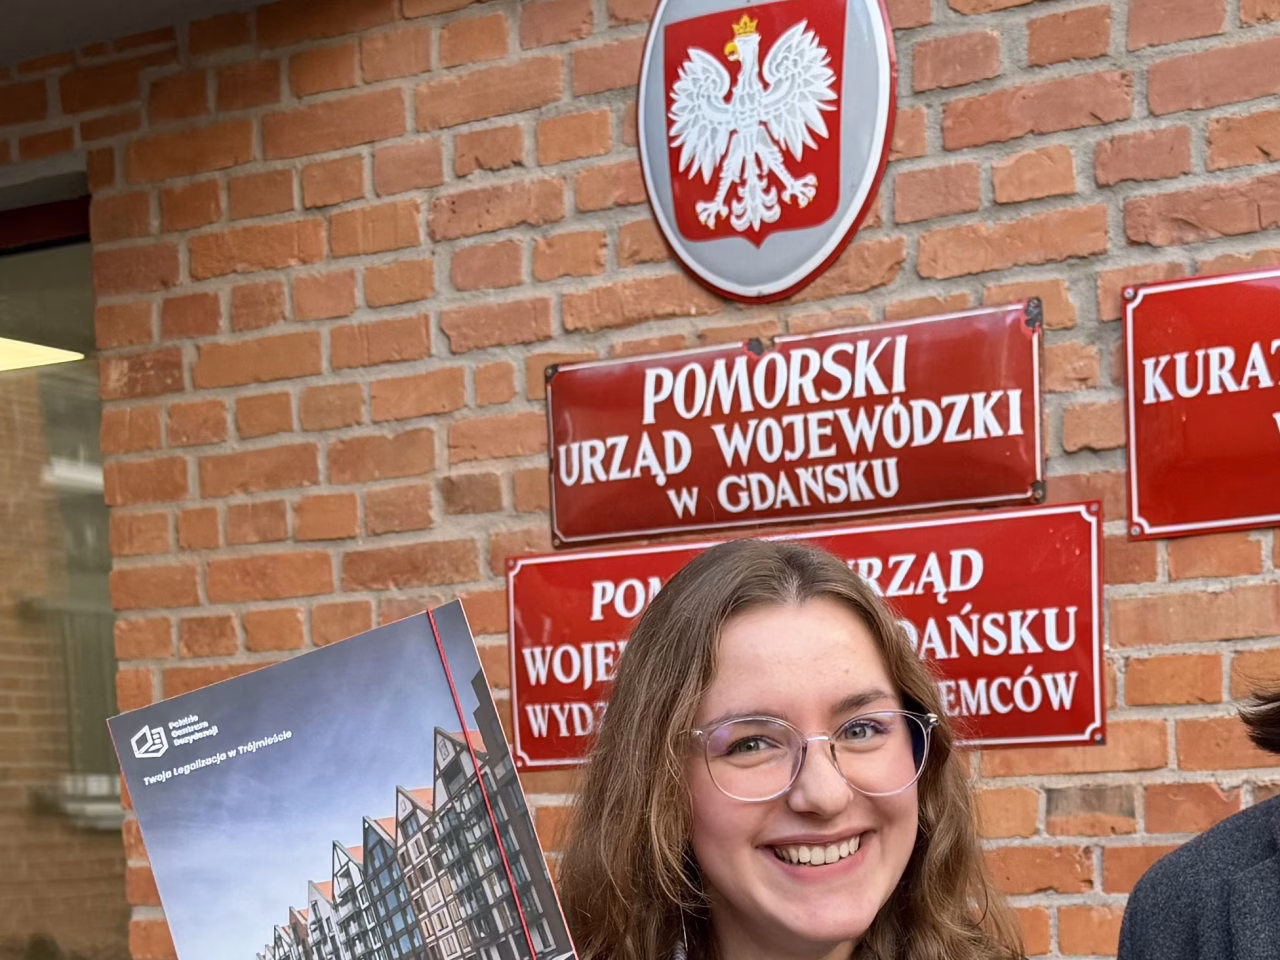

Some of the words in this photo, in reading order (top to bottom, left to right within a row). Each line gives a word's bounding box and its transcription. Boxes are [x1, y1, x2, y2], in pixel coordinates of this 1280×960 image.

[642, 335, 908, 425] POMORSKI
[557, 429, 692, 487] URZĄD
[711, 389, 1024, 468] WOJEWÓDZKI
[846, 548, 984, 605] RZĄD
[522, 640, 629, 691] WOJE
[895, 603, 1078, 660] DAŃSKU
[937, 665, 1079, 717] EMCÓW
[143, 770, 172, 786] Twoja
[173, 752, 227, 775] Legalizacja
[227, 749, 237, 758] w
